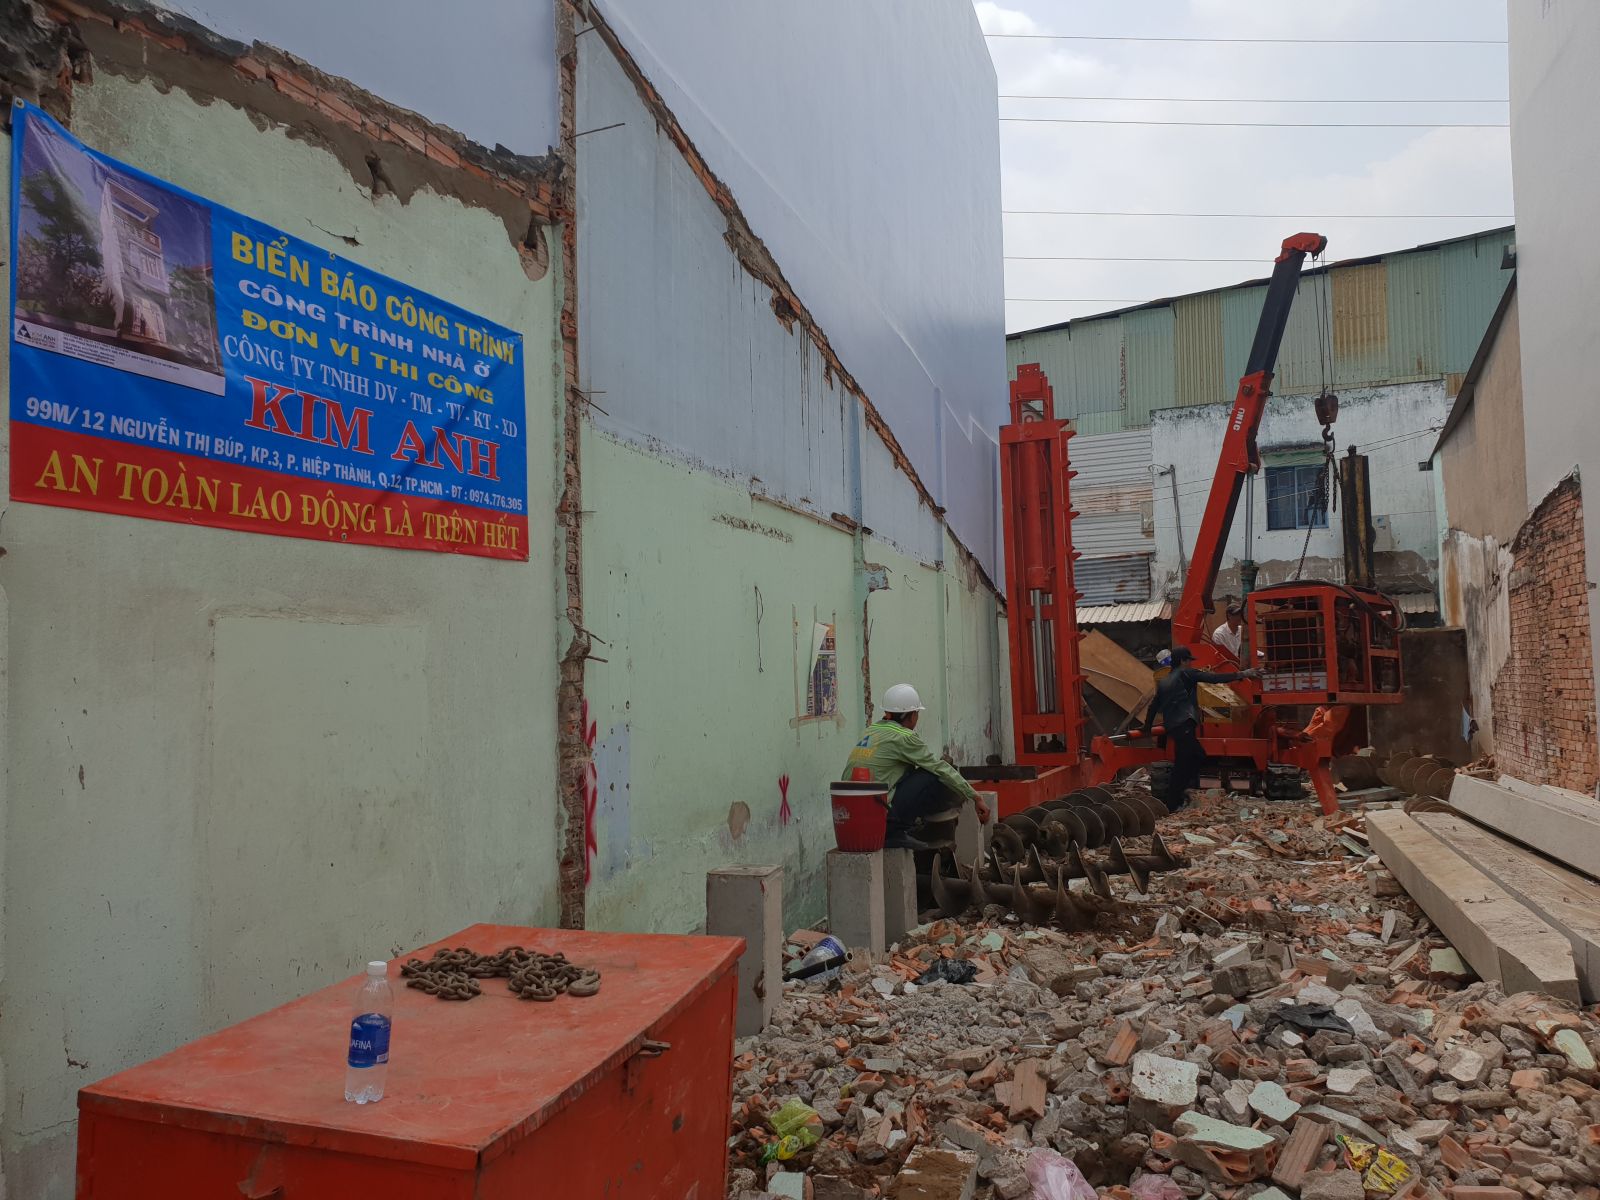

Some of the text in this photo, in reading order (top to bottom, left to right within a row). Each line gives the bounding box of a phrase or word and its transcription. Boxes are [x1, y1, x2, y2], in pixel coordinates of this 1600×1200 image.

[232, 231, 514, 365] BIỂN BÁO CÔNG TRÌNH
[239, 279, 490, 377] CÔNG TRÌNH NHÀ Ở
[224, 334, 284, 372] CÔNG
[291, 354, 315, 380] TY
[321, 364, 370, 397] TNHH
[374, 381, 397, 404] DV
[410, 392, 432, 415] TM
[473, 410, 491, 430] KT
[502, 418, 517, 438] XD
[241, 309, 493, 404] ĐƠN VỊ THI CÔNG
[81, 409, 105, 431] 12
[110, 415, 180, 447] NGUYỄN
[184, 431, 210, 455] THỊ
[214, 436, 246, 463] BÚP,
[302, 456, 330, 479] HIỆP
[334, 463, 376, 487] THÀNH,
[405, 476, 443, 495] TP.HCM
[244, 375, 500, 481] KIM ANH
[34, 450, 520, 550] AN TOÀN LAO ĐỘNG LÀ TRÊN HẾT
